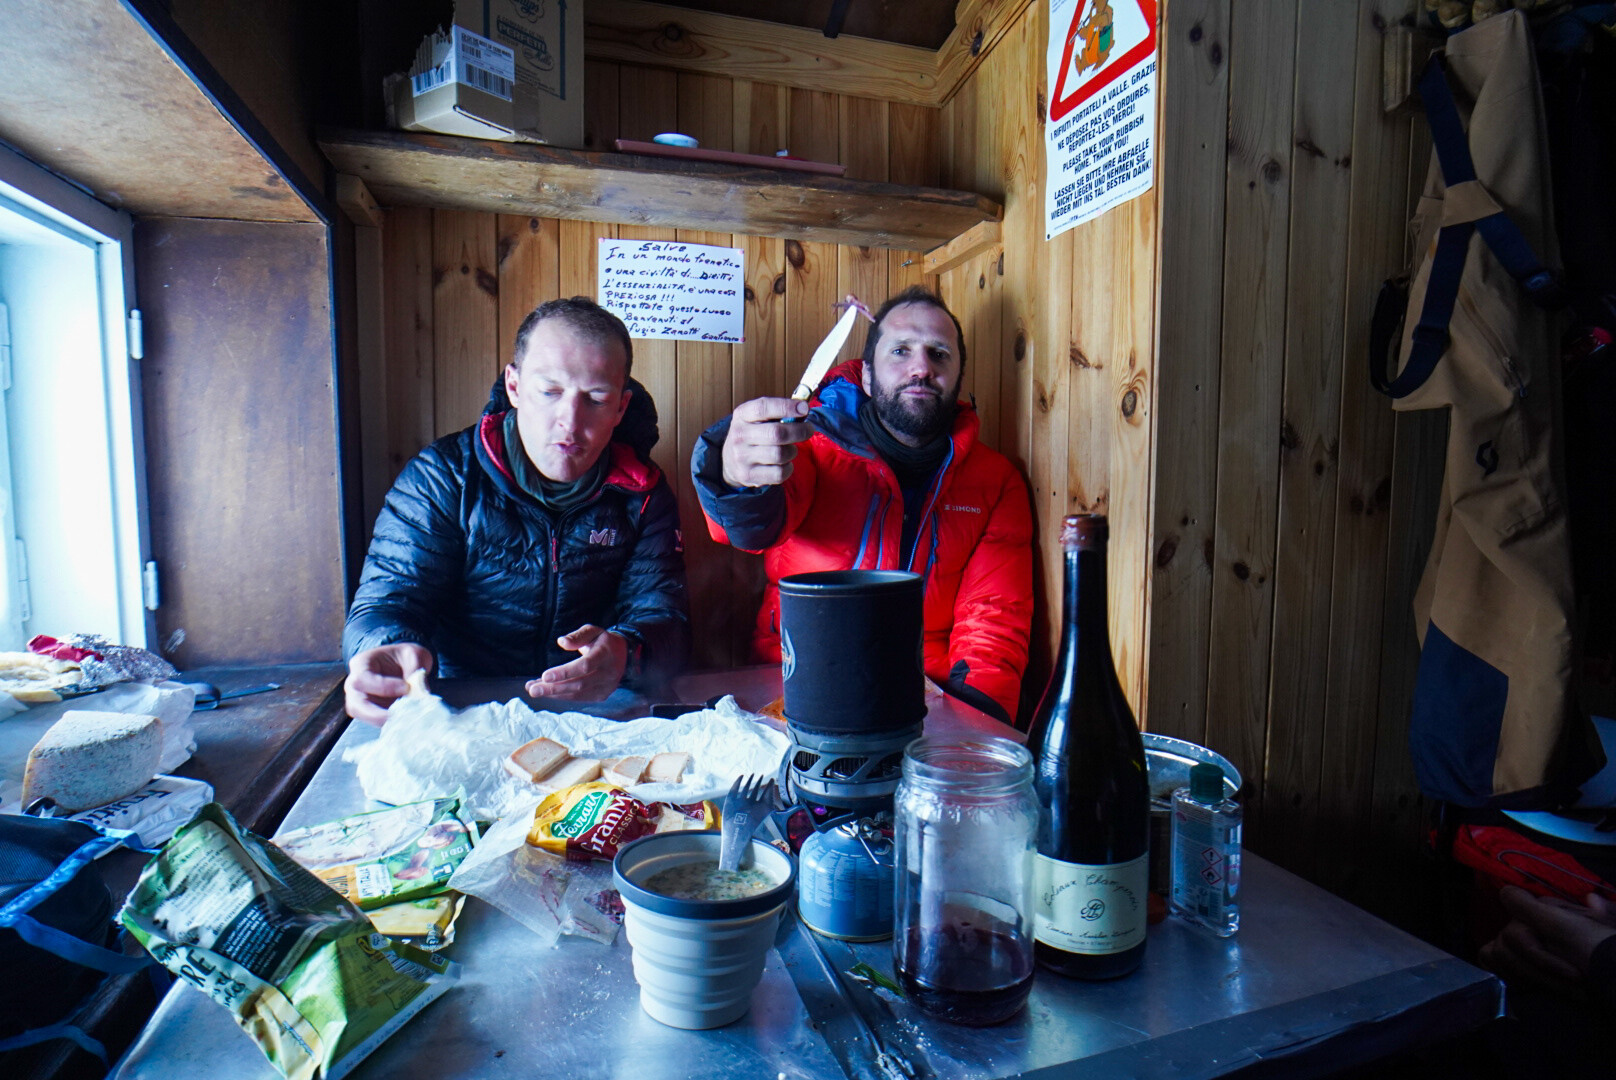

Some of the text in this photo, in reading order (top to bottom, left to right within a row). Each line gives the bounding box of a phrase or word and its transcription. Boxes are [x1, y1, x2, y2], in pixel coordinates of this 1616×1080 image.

[1053, 120, 1071, 139] RIFIUTI
[1072, 98, 1102, 126] PORTATELI
[1102, 95, 1107, 105] A
[1108, 80, 1129, 100] VALLE.
[1057, 139, 1065, 151] NE
[1090, 113, 1102, 129] PAS
[1102, 105, 1115, 120] VOS
[1116, 83, 1150, 111] ORDURES,
[1068, 103, 1136, 154] REPORTEZ-LES. MERCI!
[1062, 114, 1145, 173] PLEASE TAKE YOUR RUBBISH
[1074, 135, 1129, 175] HOME. THANK YOU!
[1050, 203, 1071, 220] WIEDER
[1072, 197, 1082, 210] MIT
[1083, 191, 1093, 204] INS
[1094, 186, 1106, 198] TAL.
[1106, 170, 1131, 191] BESTEN
[1132, 158, 1152, 178] DANK!
[1054, 138, 1149, 200] LASSEN SIE BITTE IHRE ABFAELLE
[1056, 192, 1073, 208] NICHT
[1074, 182, 1093, 200] LIEGEN
[1094, 174, 1105, 188] UND
[1106, 158, 1134, 178] NEHMEN
[1136, 151, 1146, 165] SIE
[606, 246, 625, 260] In
[655, 253, 692, 264] mondo
[694, 252, 740, 269] frenetico
[615, 268, 635, 276] una
[606, 299, 663, 312] Rispettate
[669, 305, 700, 315] questo
[660, 293, 675, 302] !!!
[719, 289, 736, 297] cosa
[624, 312, 699, 325] Benvenuti al
[553, 795, 600, 839] Ferrari
